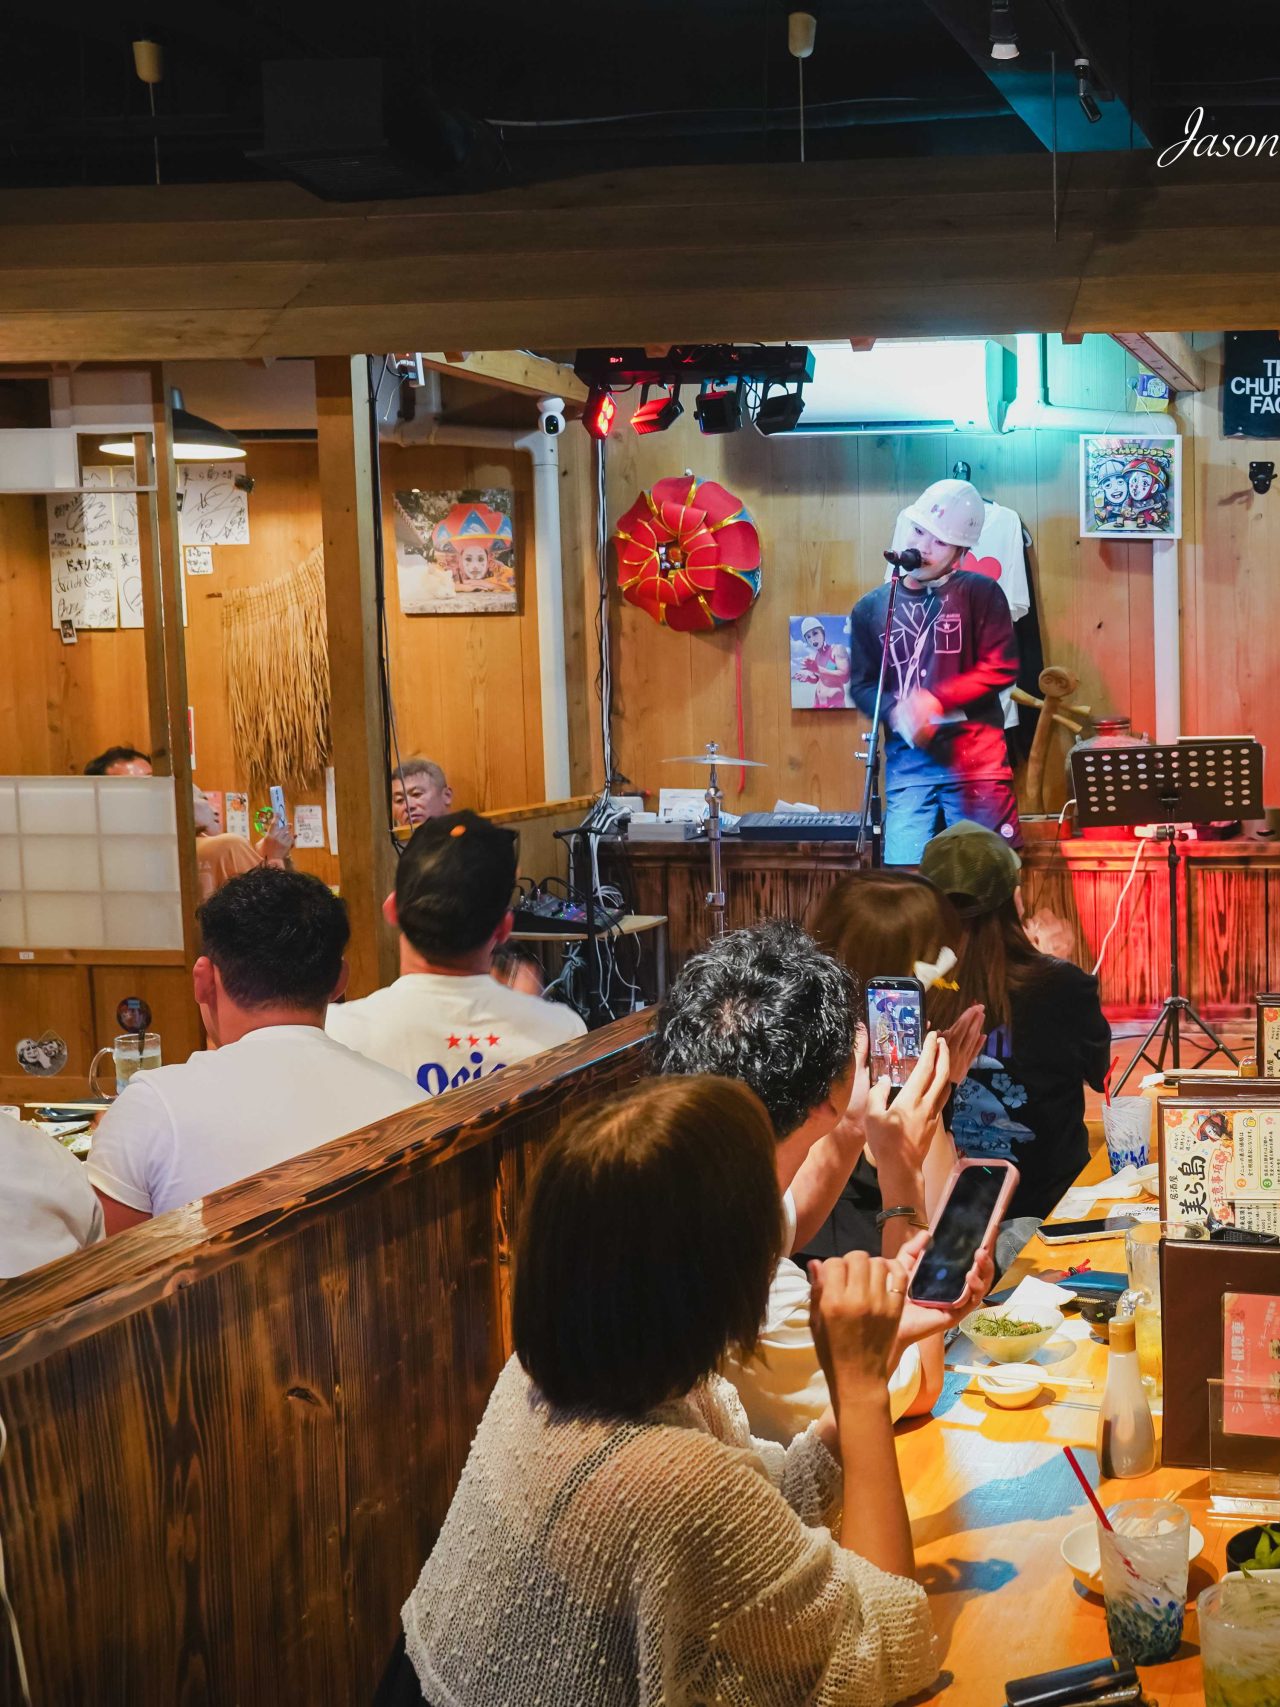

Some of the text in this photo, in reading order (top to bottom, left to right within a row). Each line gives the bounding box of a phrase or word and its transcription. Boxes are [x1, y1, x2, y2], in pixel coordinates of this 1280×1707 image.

[416, 1051, 508, 1096] Ori
[1169, 1175, 1179, 1200] 居酒屋
[1178, 1155, 1208, 1215] 美ら島
[1211, 1164, 1224, 1207] 注意事項
[1231, 1321, 1245, 1414] ショット観覧車
